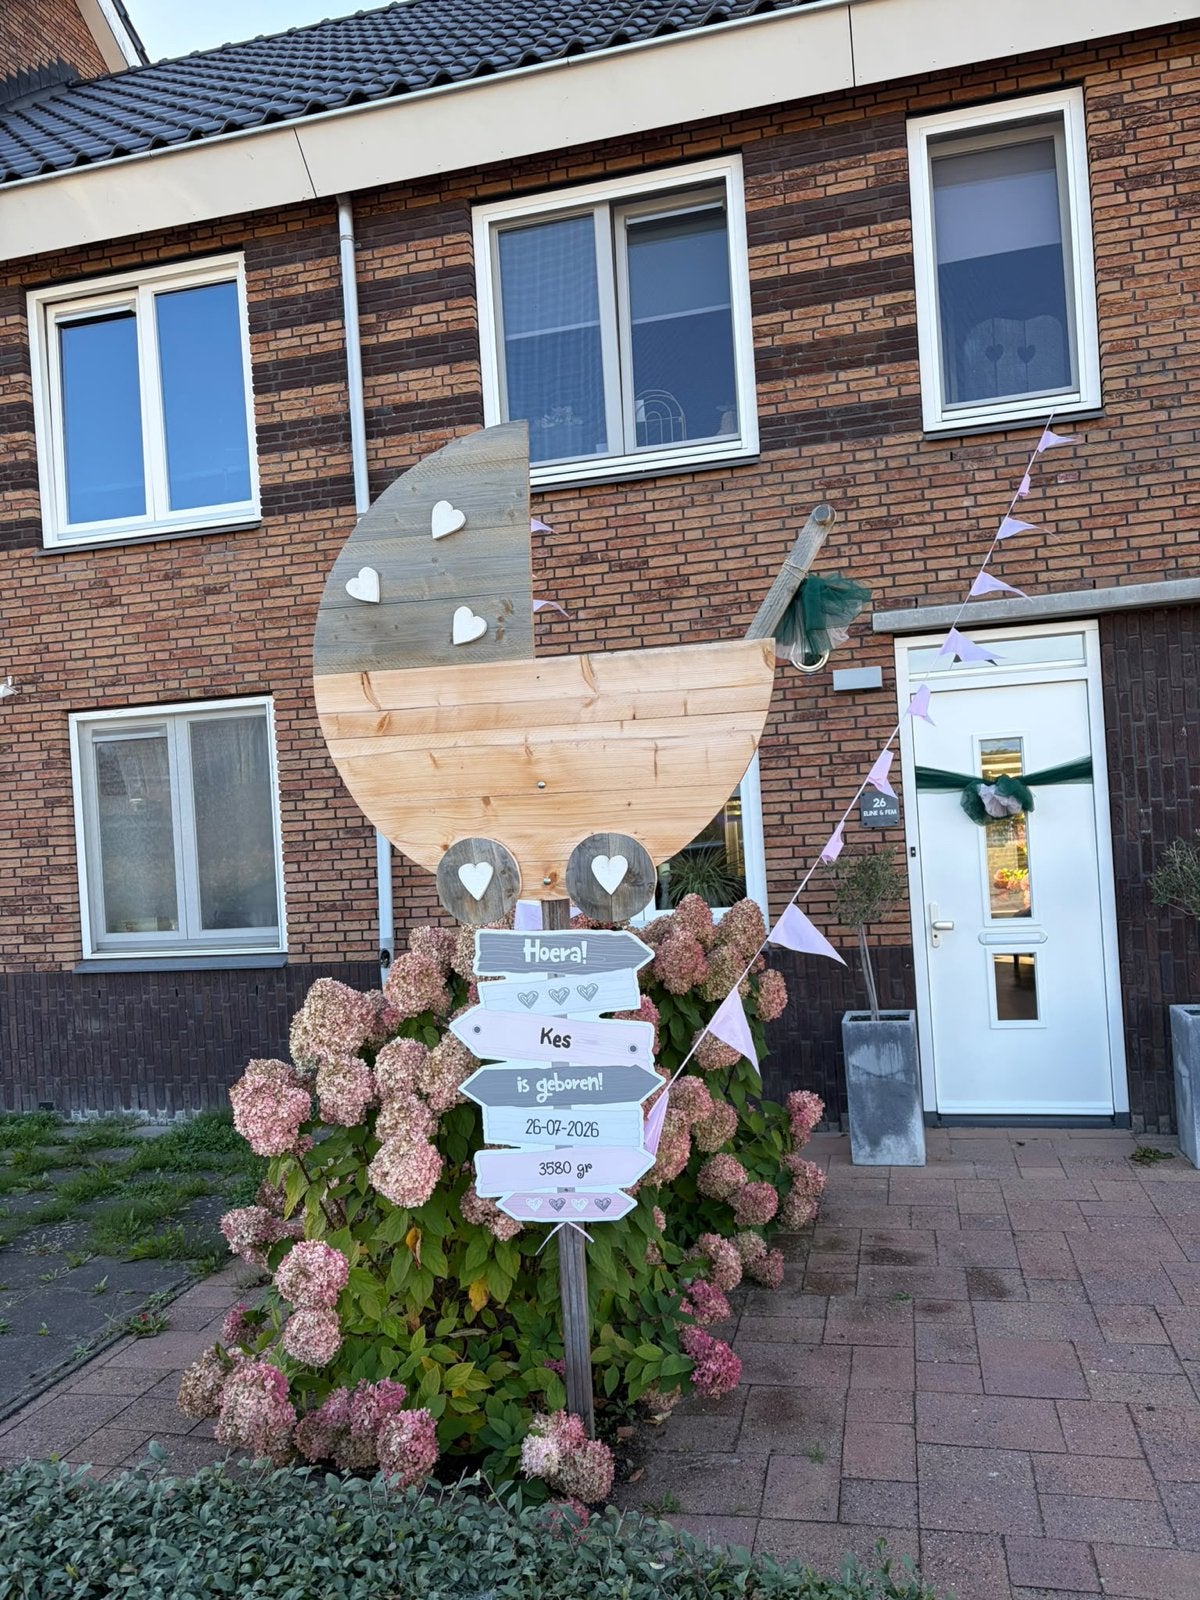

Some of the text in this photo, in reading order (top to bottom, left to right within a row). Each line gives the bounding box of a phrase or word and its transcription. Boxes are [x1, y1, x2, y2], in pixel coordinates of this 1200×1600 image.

[873, 797, 887, 808] 26
[523, 938, 588, 964] Hoera!
[540, 1027, 572, 1049] Kes
[516, 1072, 603, 1103] is geboren!
[525, 1118, 600, 1138] 26-07-2026
[538, 1160, 593, 1179] 3580 gr
